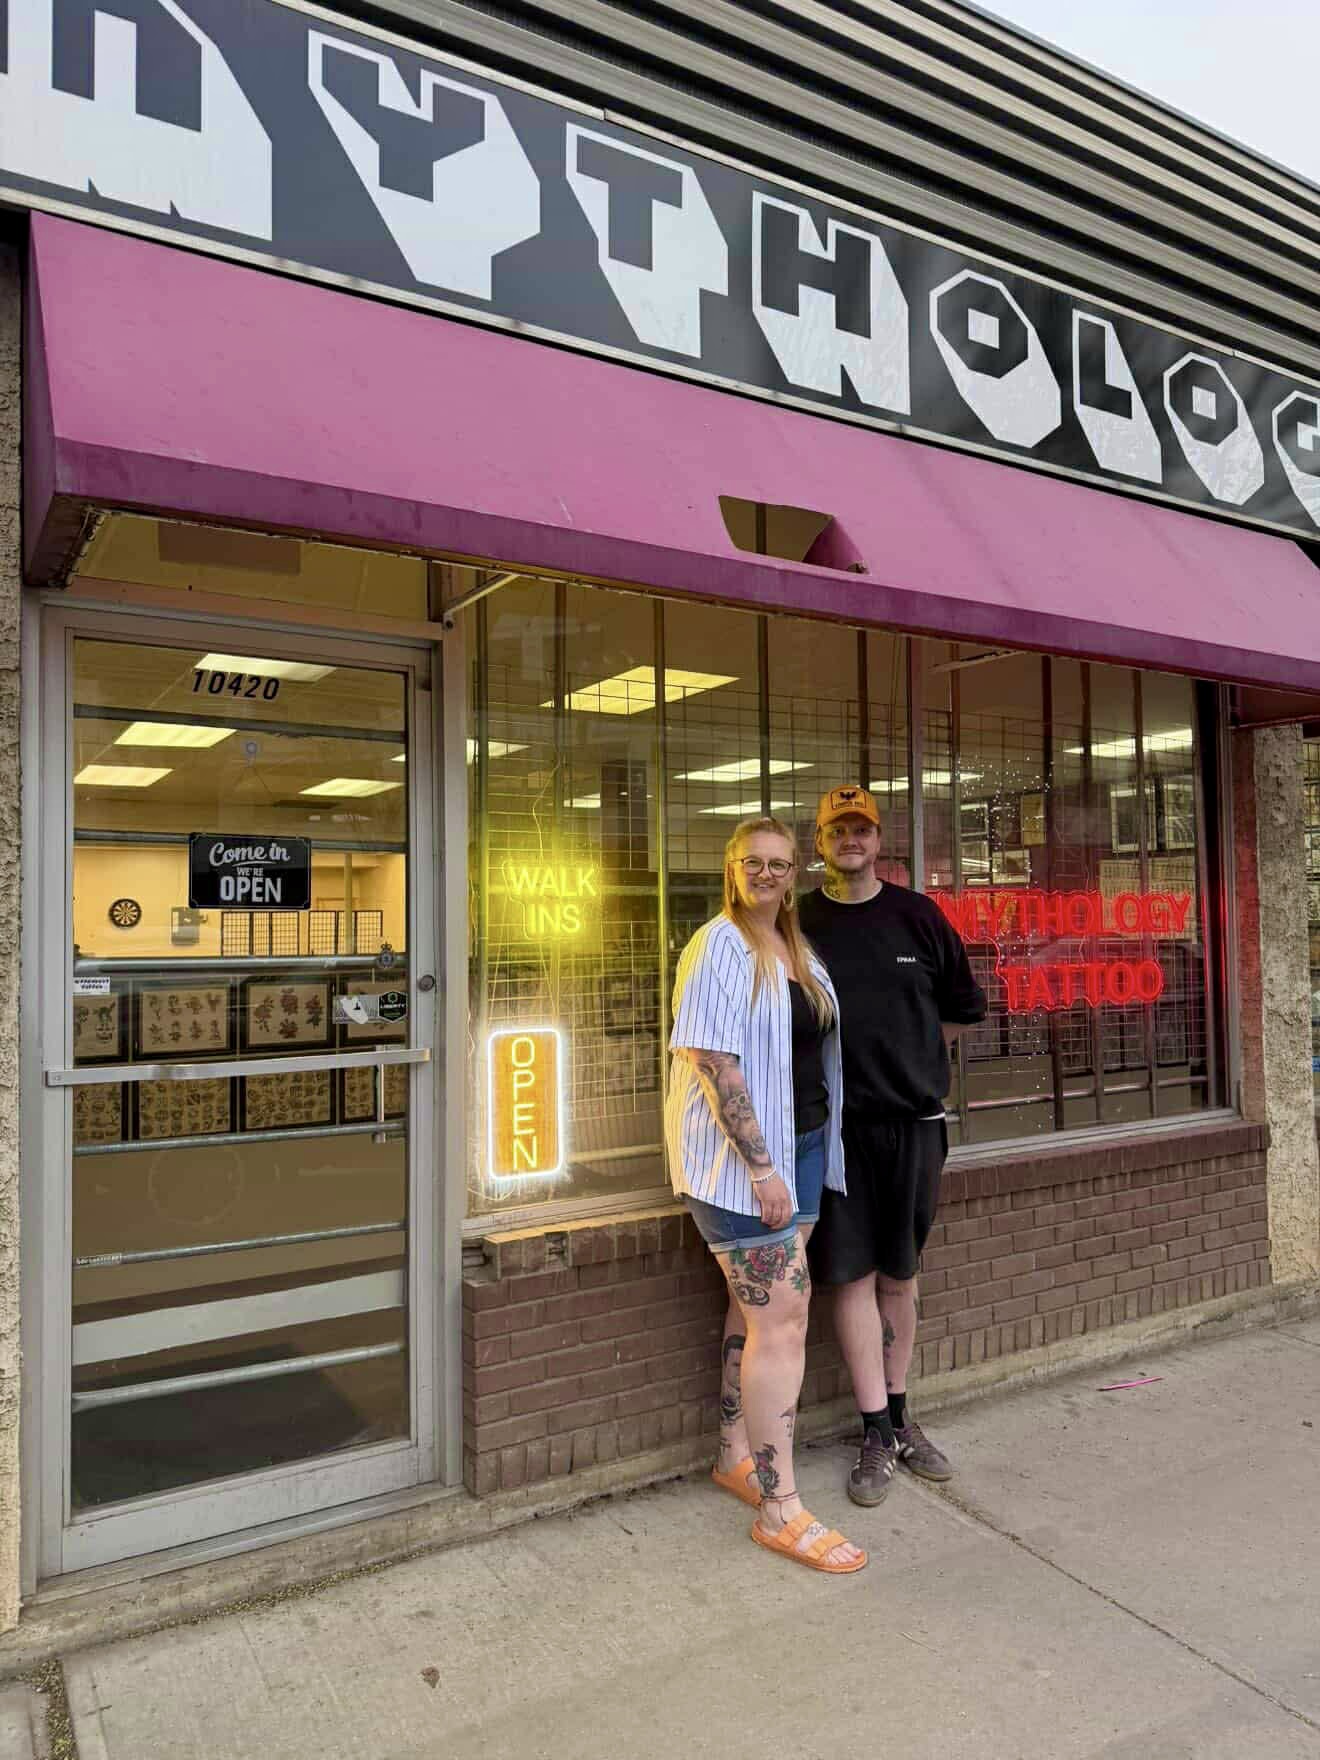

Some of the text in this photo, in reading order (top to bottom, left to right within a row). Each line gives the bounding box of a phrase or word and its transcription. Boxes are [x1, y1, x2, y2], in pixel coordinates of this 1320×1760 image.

[192, 671, 280, 700] 10420
[209, 842, 291, 867] Come in
[236, 867, 264, 876] WE'RE
[508, 864, 597, 897] WALK
[220, 875, 282, 903] OPEN
[527, 903, 580, 934] INS
[1003, 960, 1163, 1010] TATTOO
[511, 1036, 537, 1170] OPEN
